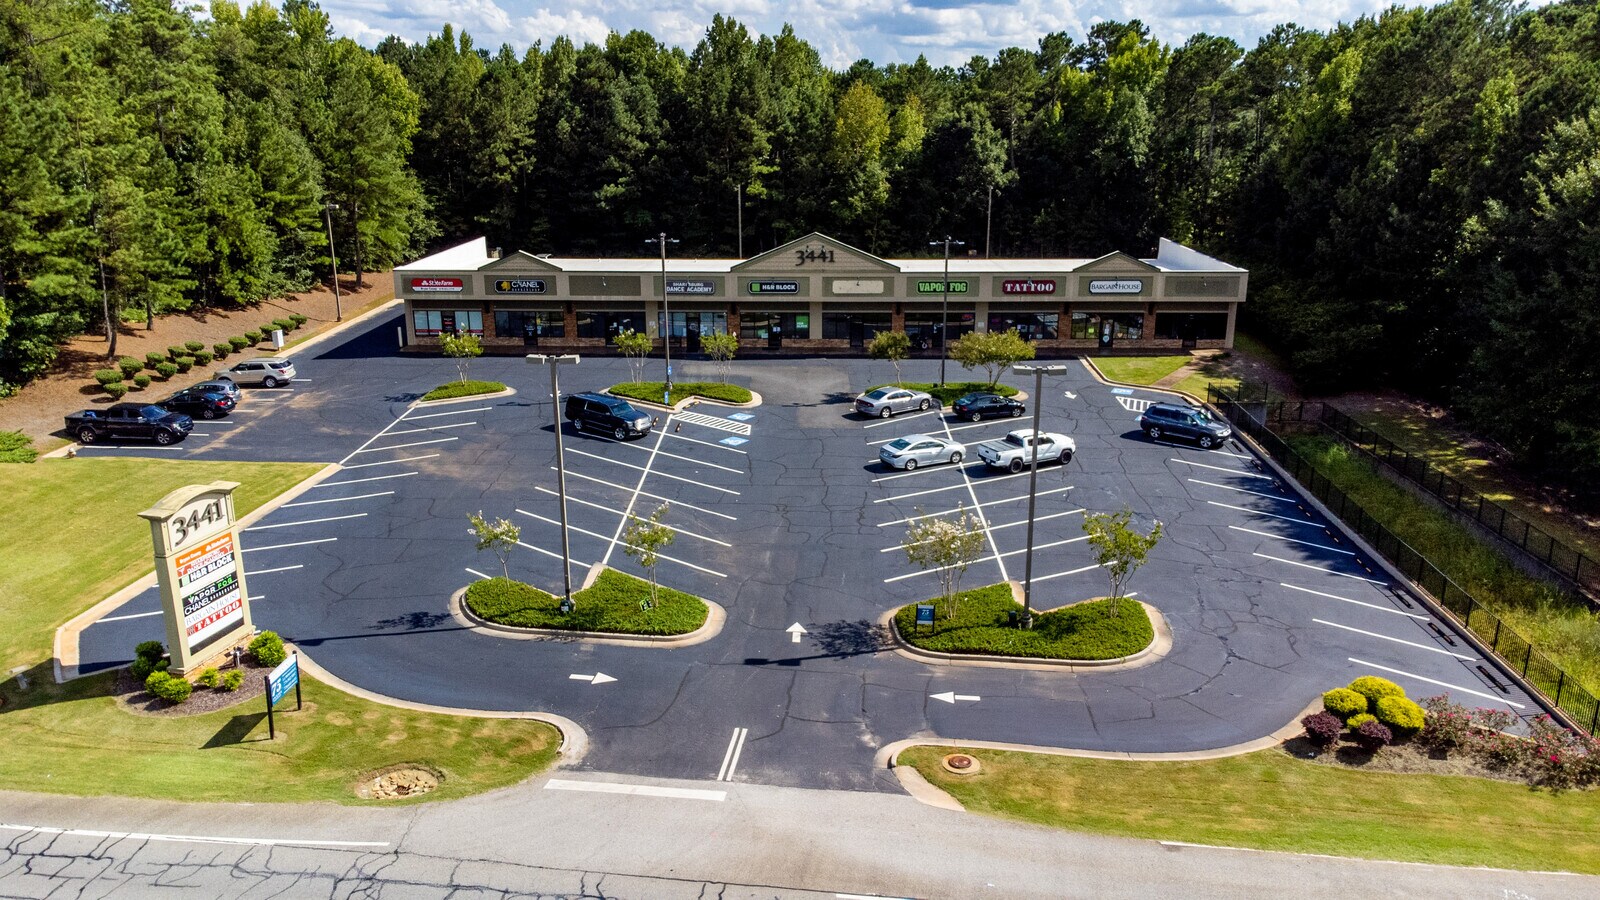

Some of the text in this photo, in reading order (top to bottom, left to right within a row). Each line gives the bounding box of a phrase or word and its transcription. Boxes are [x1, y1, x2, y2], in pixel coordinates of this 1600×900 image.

[795, 250, 835, 266] 3441
[949, 282, 966, 291] FOG
[1005, 283, 1054, 292] TATTOO
[172, 500, 224, 547] 3441
[207, 553, 232, 573] BLOCK
[188, 586, 216, 603] VAPOR
[217, 576, 232, 589] FOG
[184, 598, 210, 615] CHANEL
[195, 602, 240, 630] TATTOO
